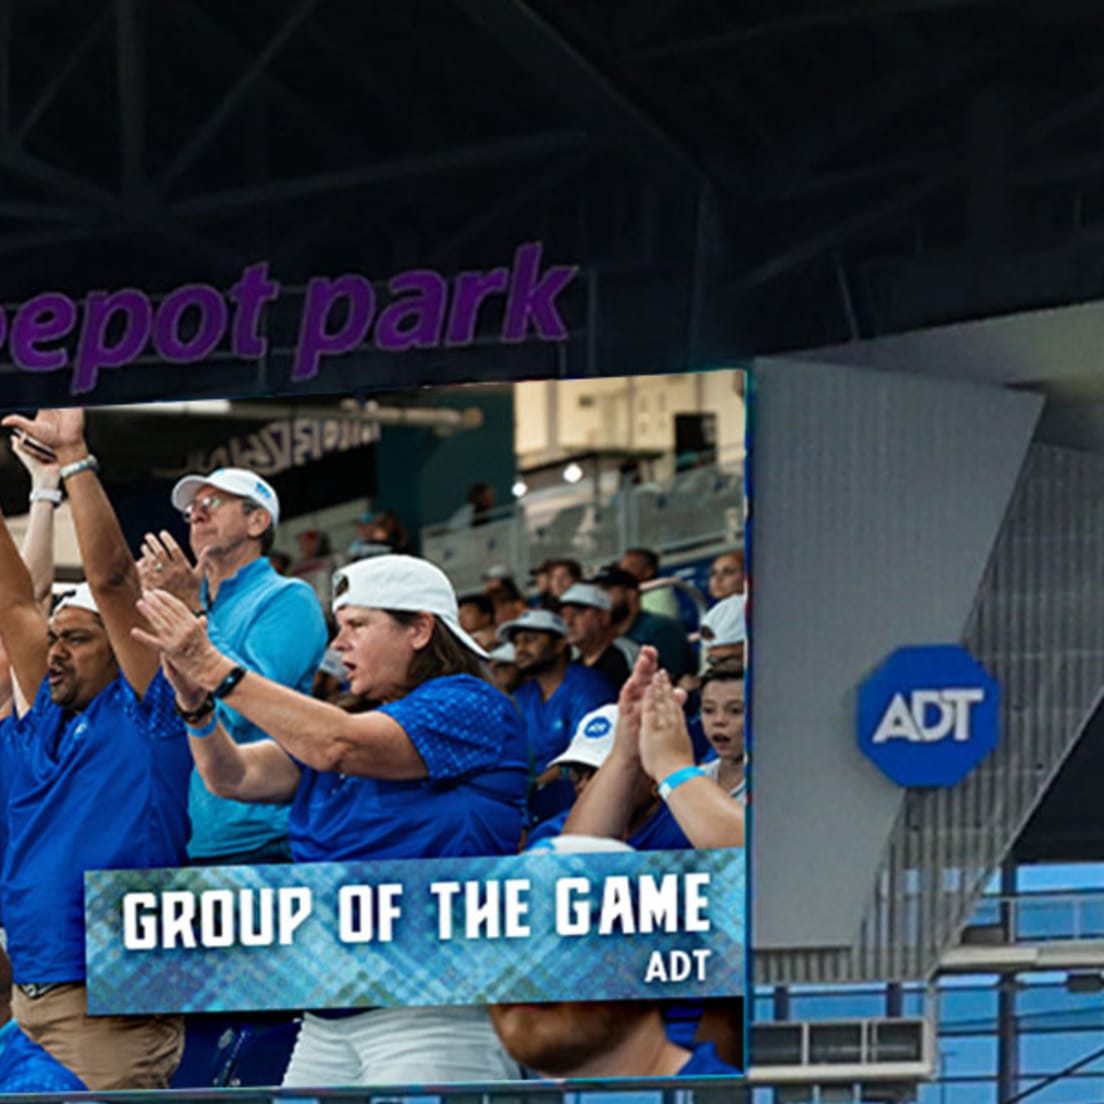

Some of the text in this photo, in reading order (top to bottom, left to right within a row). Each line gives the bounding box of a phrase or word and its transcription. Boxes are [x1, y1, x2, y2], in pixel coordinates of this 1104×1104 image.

[289, 242, 580, 381] park
[872, 688, 985, 743] ADT
[121, 873, 710, 949] GROUP OF THE GAME
[643, 949, 711, 983] ADT
